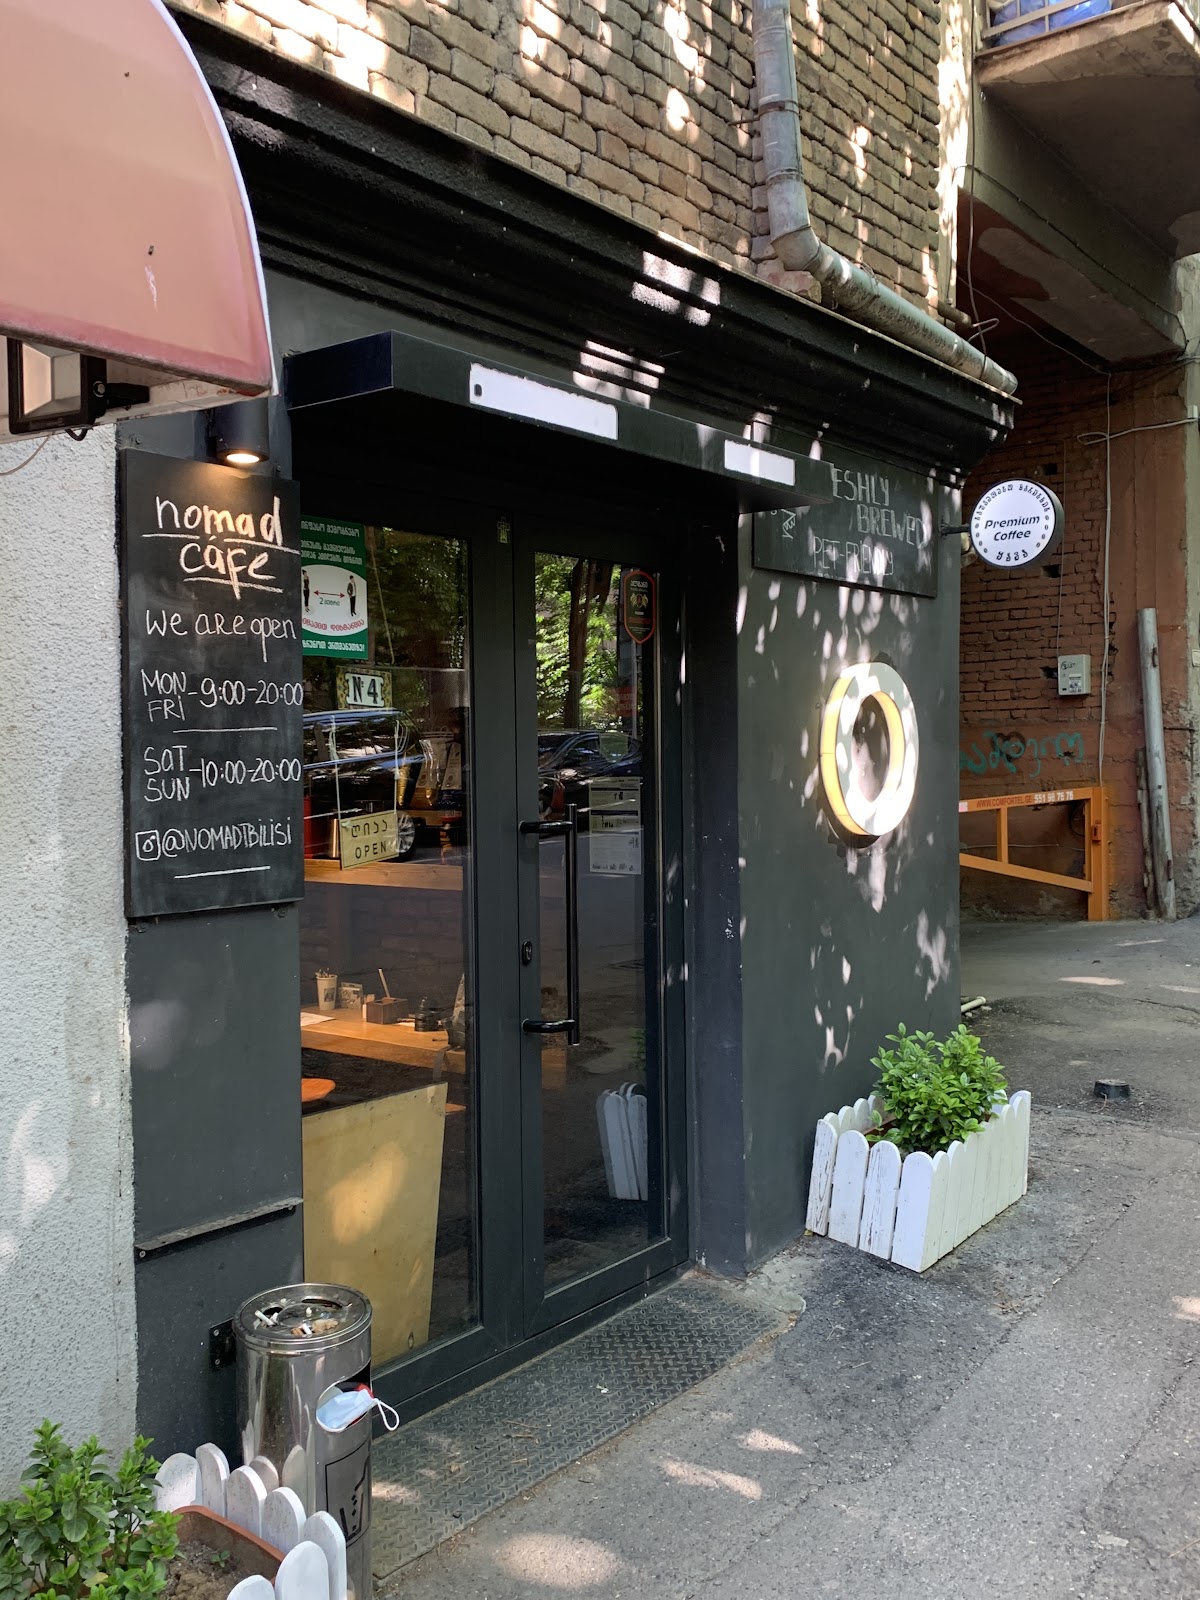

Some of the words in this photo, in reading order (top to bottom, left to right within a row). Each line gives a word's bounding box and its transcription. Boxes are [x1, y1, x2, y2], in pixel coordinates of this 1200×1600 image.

[833, 467, 889, 506] ESHLY
[156, 495, 283, 547] nomad
[984, 515, 1040, 529] Premium
[994, 530, 1031, 541] Coffee
[996, 549, 1029, 562] ყავა
[250, 618, 297, 662] open
[367, 678, 378, 704] 4
[144, 777, 189, 802] SUN
[351, 819, 388, 838] ღიაა
[355, 841, 387, 859] OPEN
